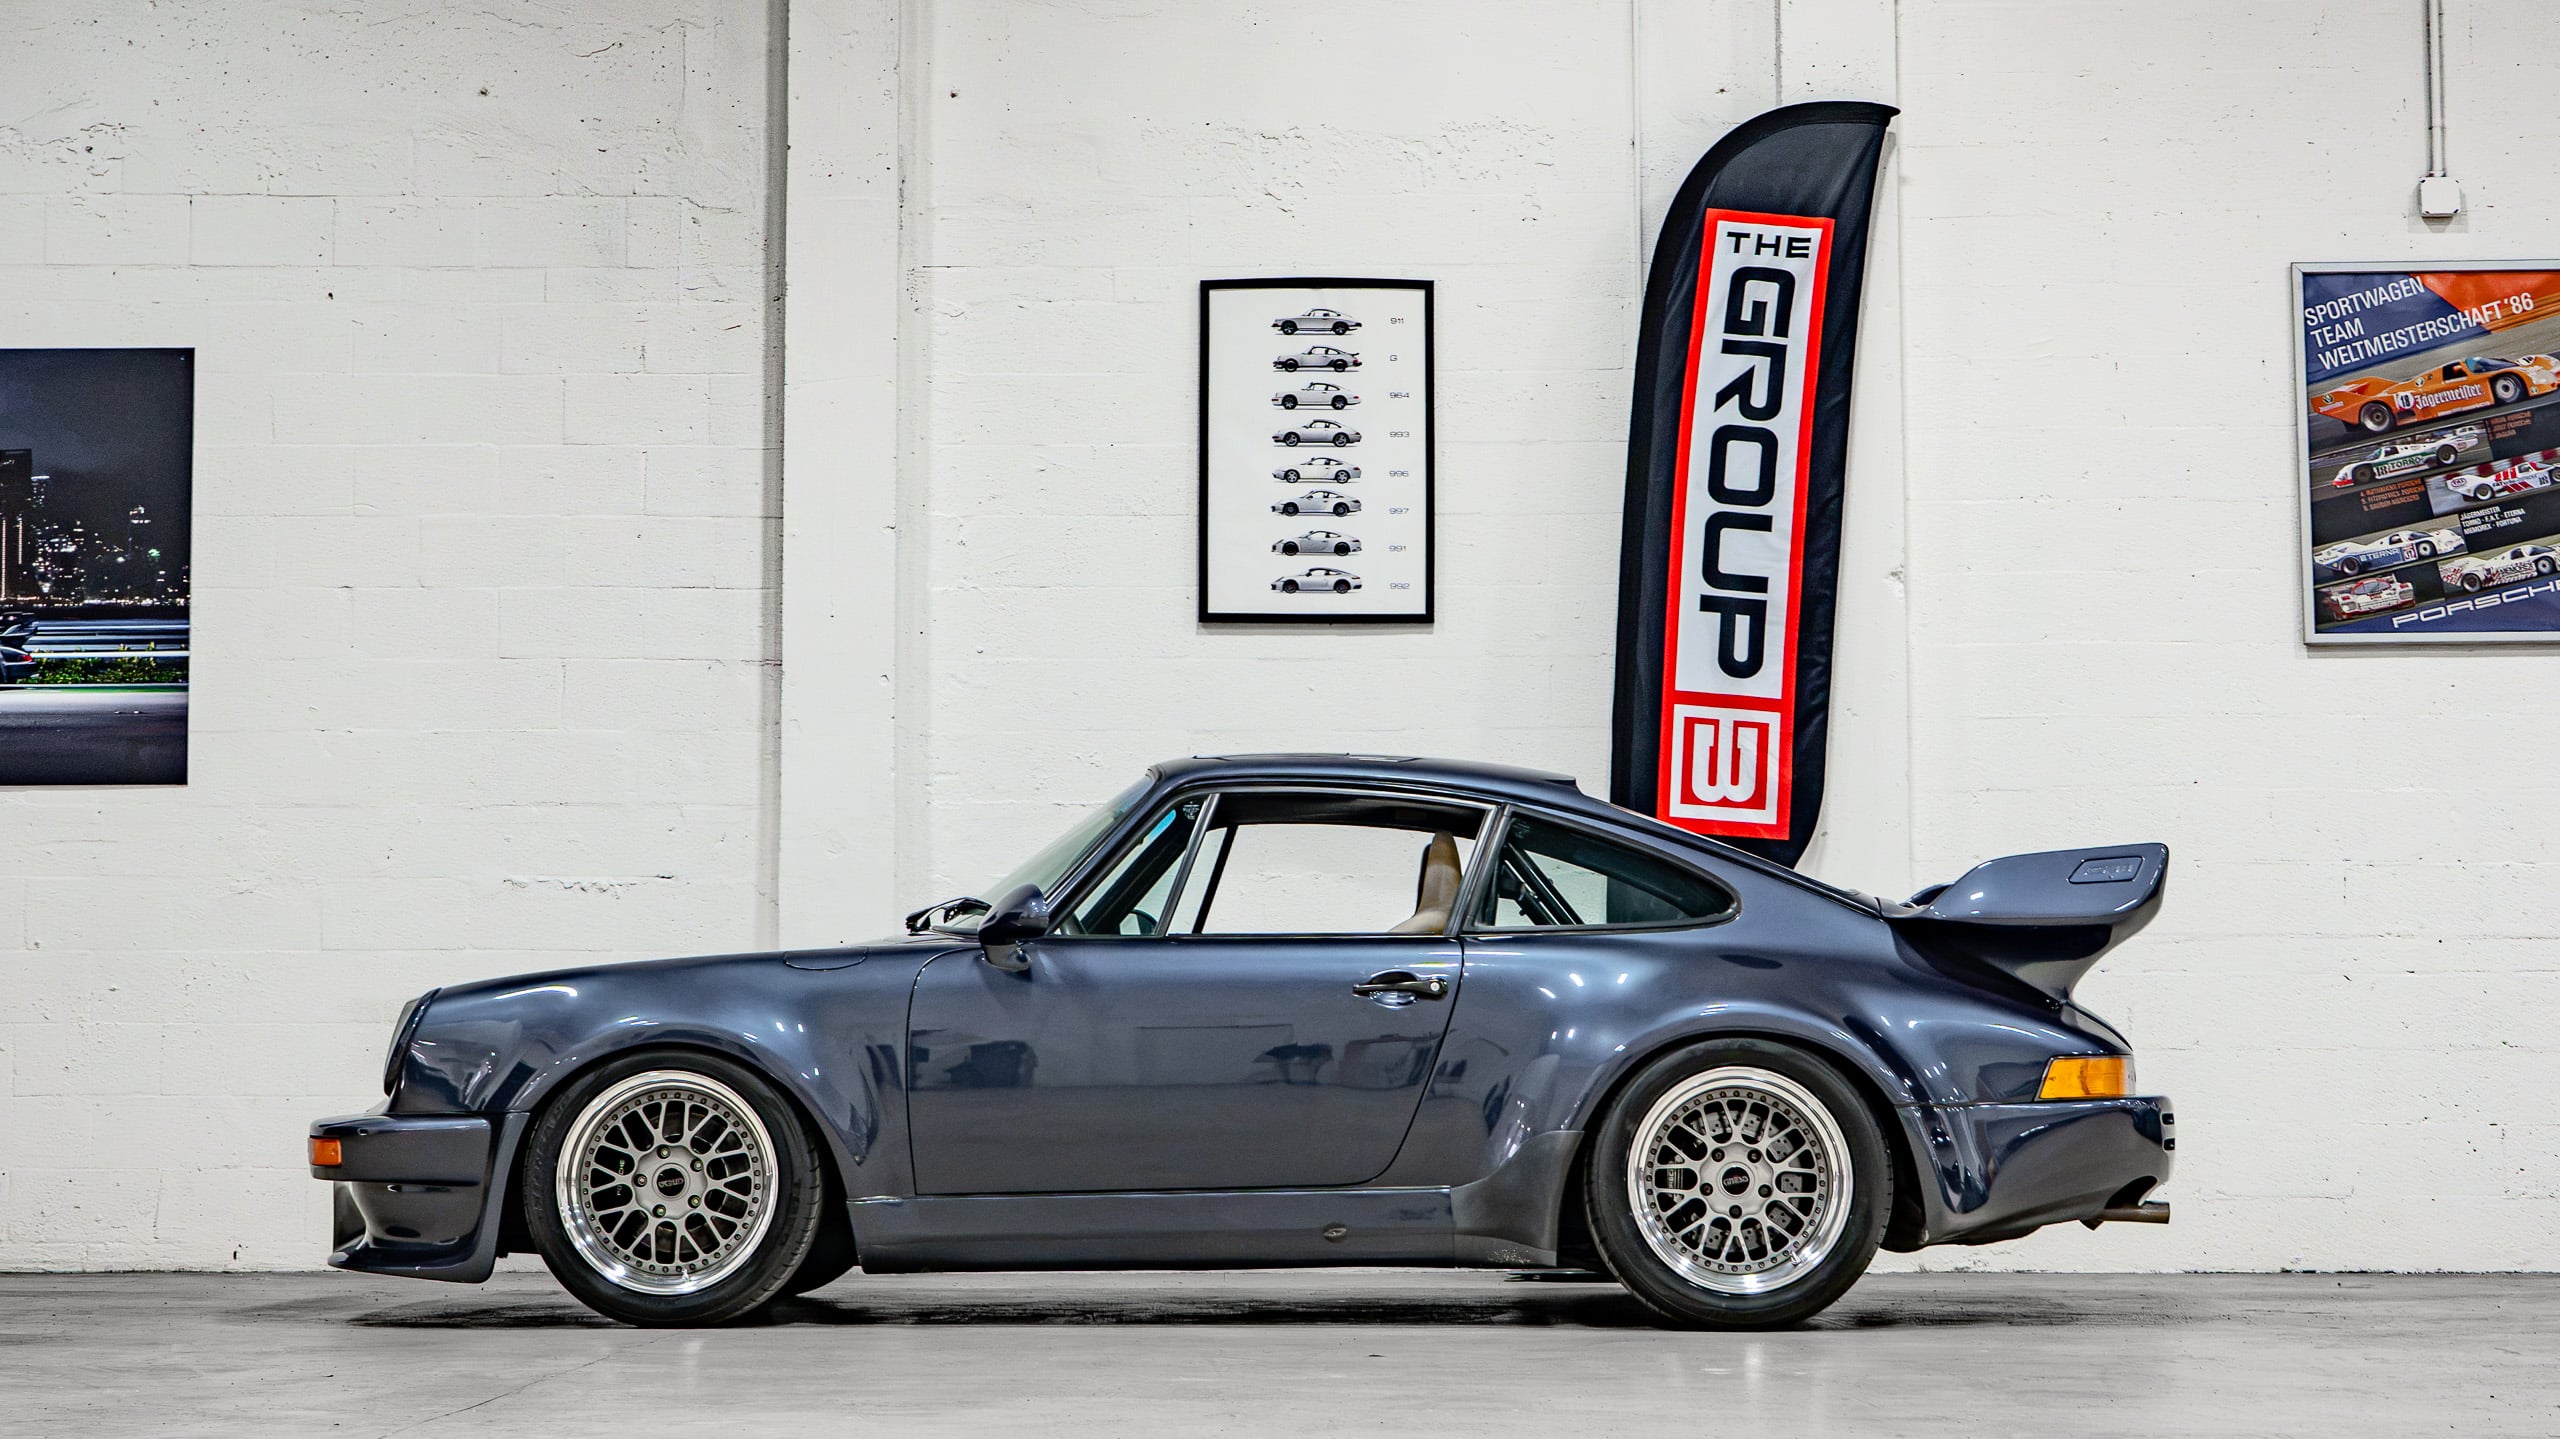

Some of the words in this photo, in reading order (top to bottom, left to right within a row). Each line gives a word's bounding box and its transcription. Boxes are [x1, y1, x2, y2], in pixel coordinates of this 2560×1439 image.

[1727, 231, 1812, 258] THE
[2304, 275, 2426, 327] SPORTWAGEN
[1390, 317, 1404, 325] 911
[2309, 317, 2365, 348] TEAM
[2317, 300, 2502, 370] WELTMEISTERSCHAFT
[1390, 354, 1398, 362] G
[1389, 391, 1410, 399] 964
[1699, 266, 1796, 679] GROUP
[1390, 582, 1410, 590] 992
[2392, 579, 2560, 628] PORSCH
